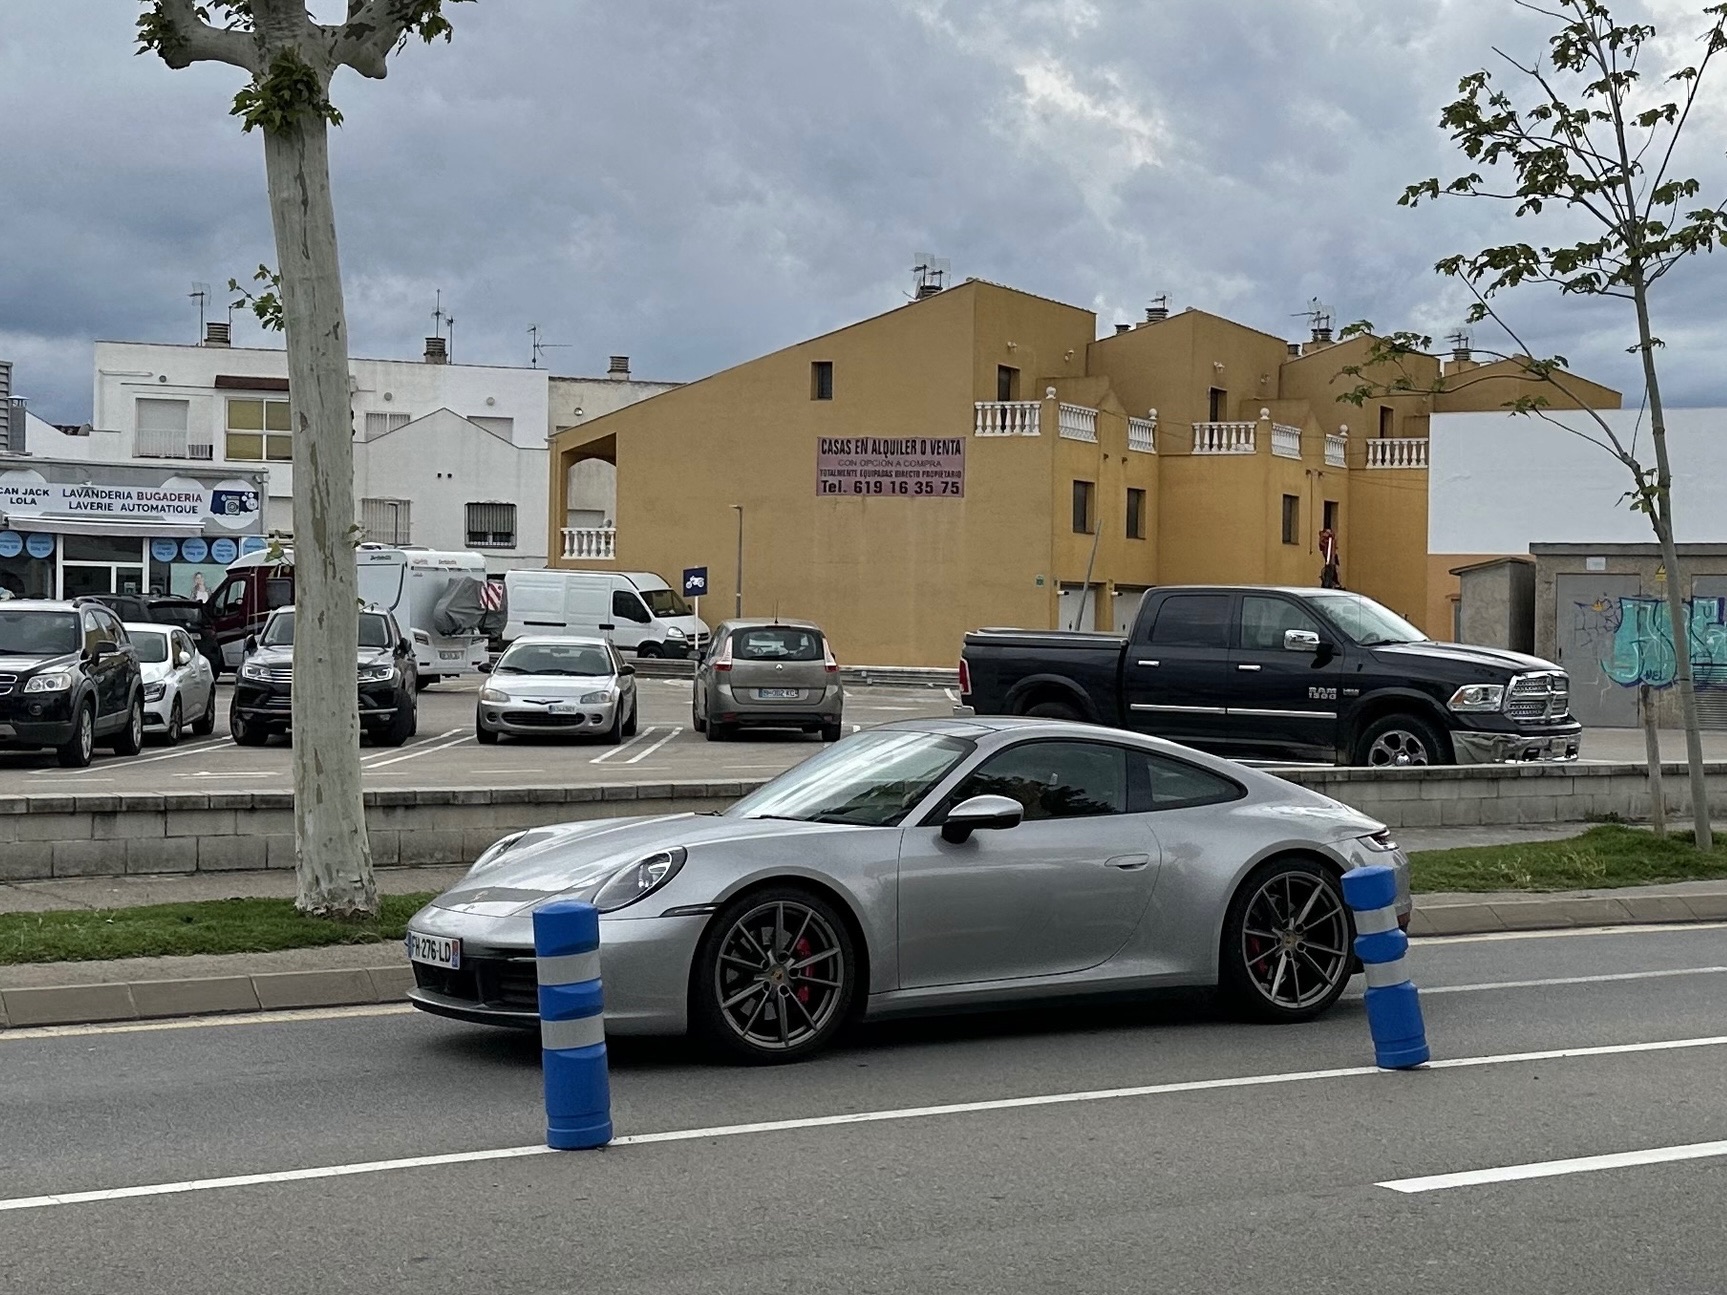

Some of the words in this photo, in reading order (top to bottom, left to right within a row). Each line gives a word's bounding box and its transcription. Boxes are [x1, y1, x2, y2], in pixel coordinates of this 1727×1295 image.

[821, 438, 851, 456] CASAS
[854, 438, 868, 456] EN
[871, 438, 917, 458] ALQUILER
[920, 439, 927, 456] O
[930, 439, 961, 456] VENTA
[837, 459, 858, 467] CON
[895, 459, 902, 468] A
[903, 460, 942, 468] COMPRA
[819, 469, 858, 478] TOTALMENTE
[860, 470, 893, 479] EQUIPADAS
[895, 470, 920, 479] DIRECTO
[921, 470, 962, 479] PROPIETARIO
[821, 479, 847, 493] Tel.
[853, 480, 883, 494] 619
[890, 480, 909, 494] 16
[914, 481, 934, 494] 35
[940, 481, 960, 494] 75
[22, 488, 50, 496] JACK
[62, 488, 133, 500] LAVANDERIA
[136, 491, 203, 503] BUGADERIA
[9, 497, 37, 505] LOLA
[68, 501, 114, 511] LAVERIE
[120, 503, 199, 514] AUTOMATIQUE
[1308, 686, 1337, 694] RAM
